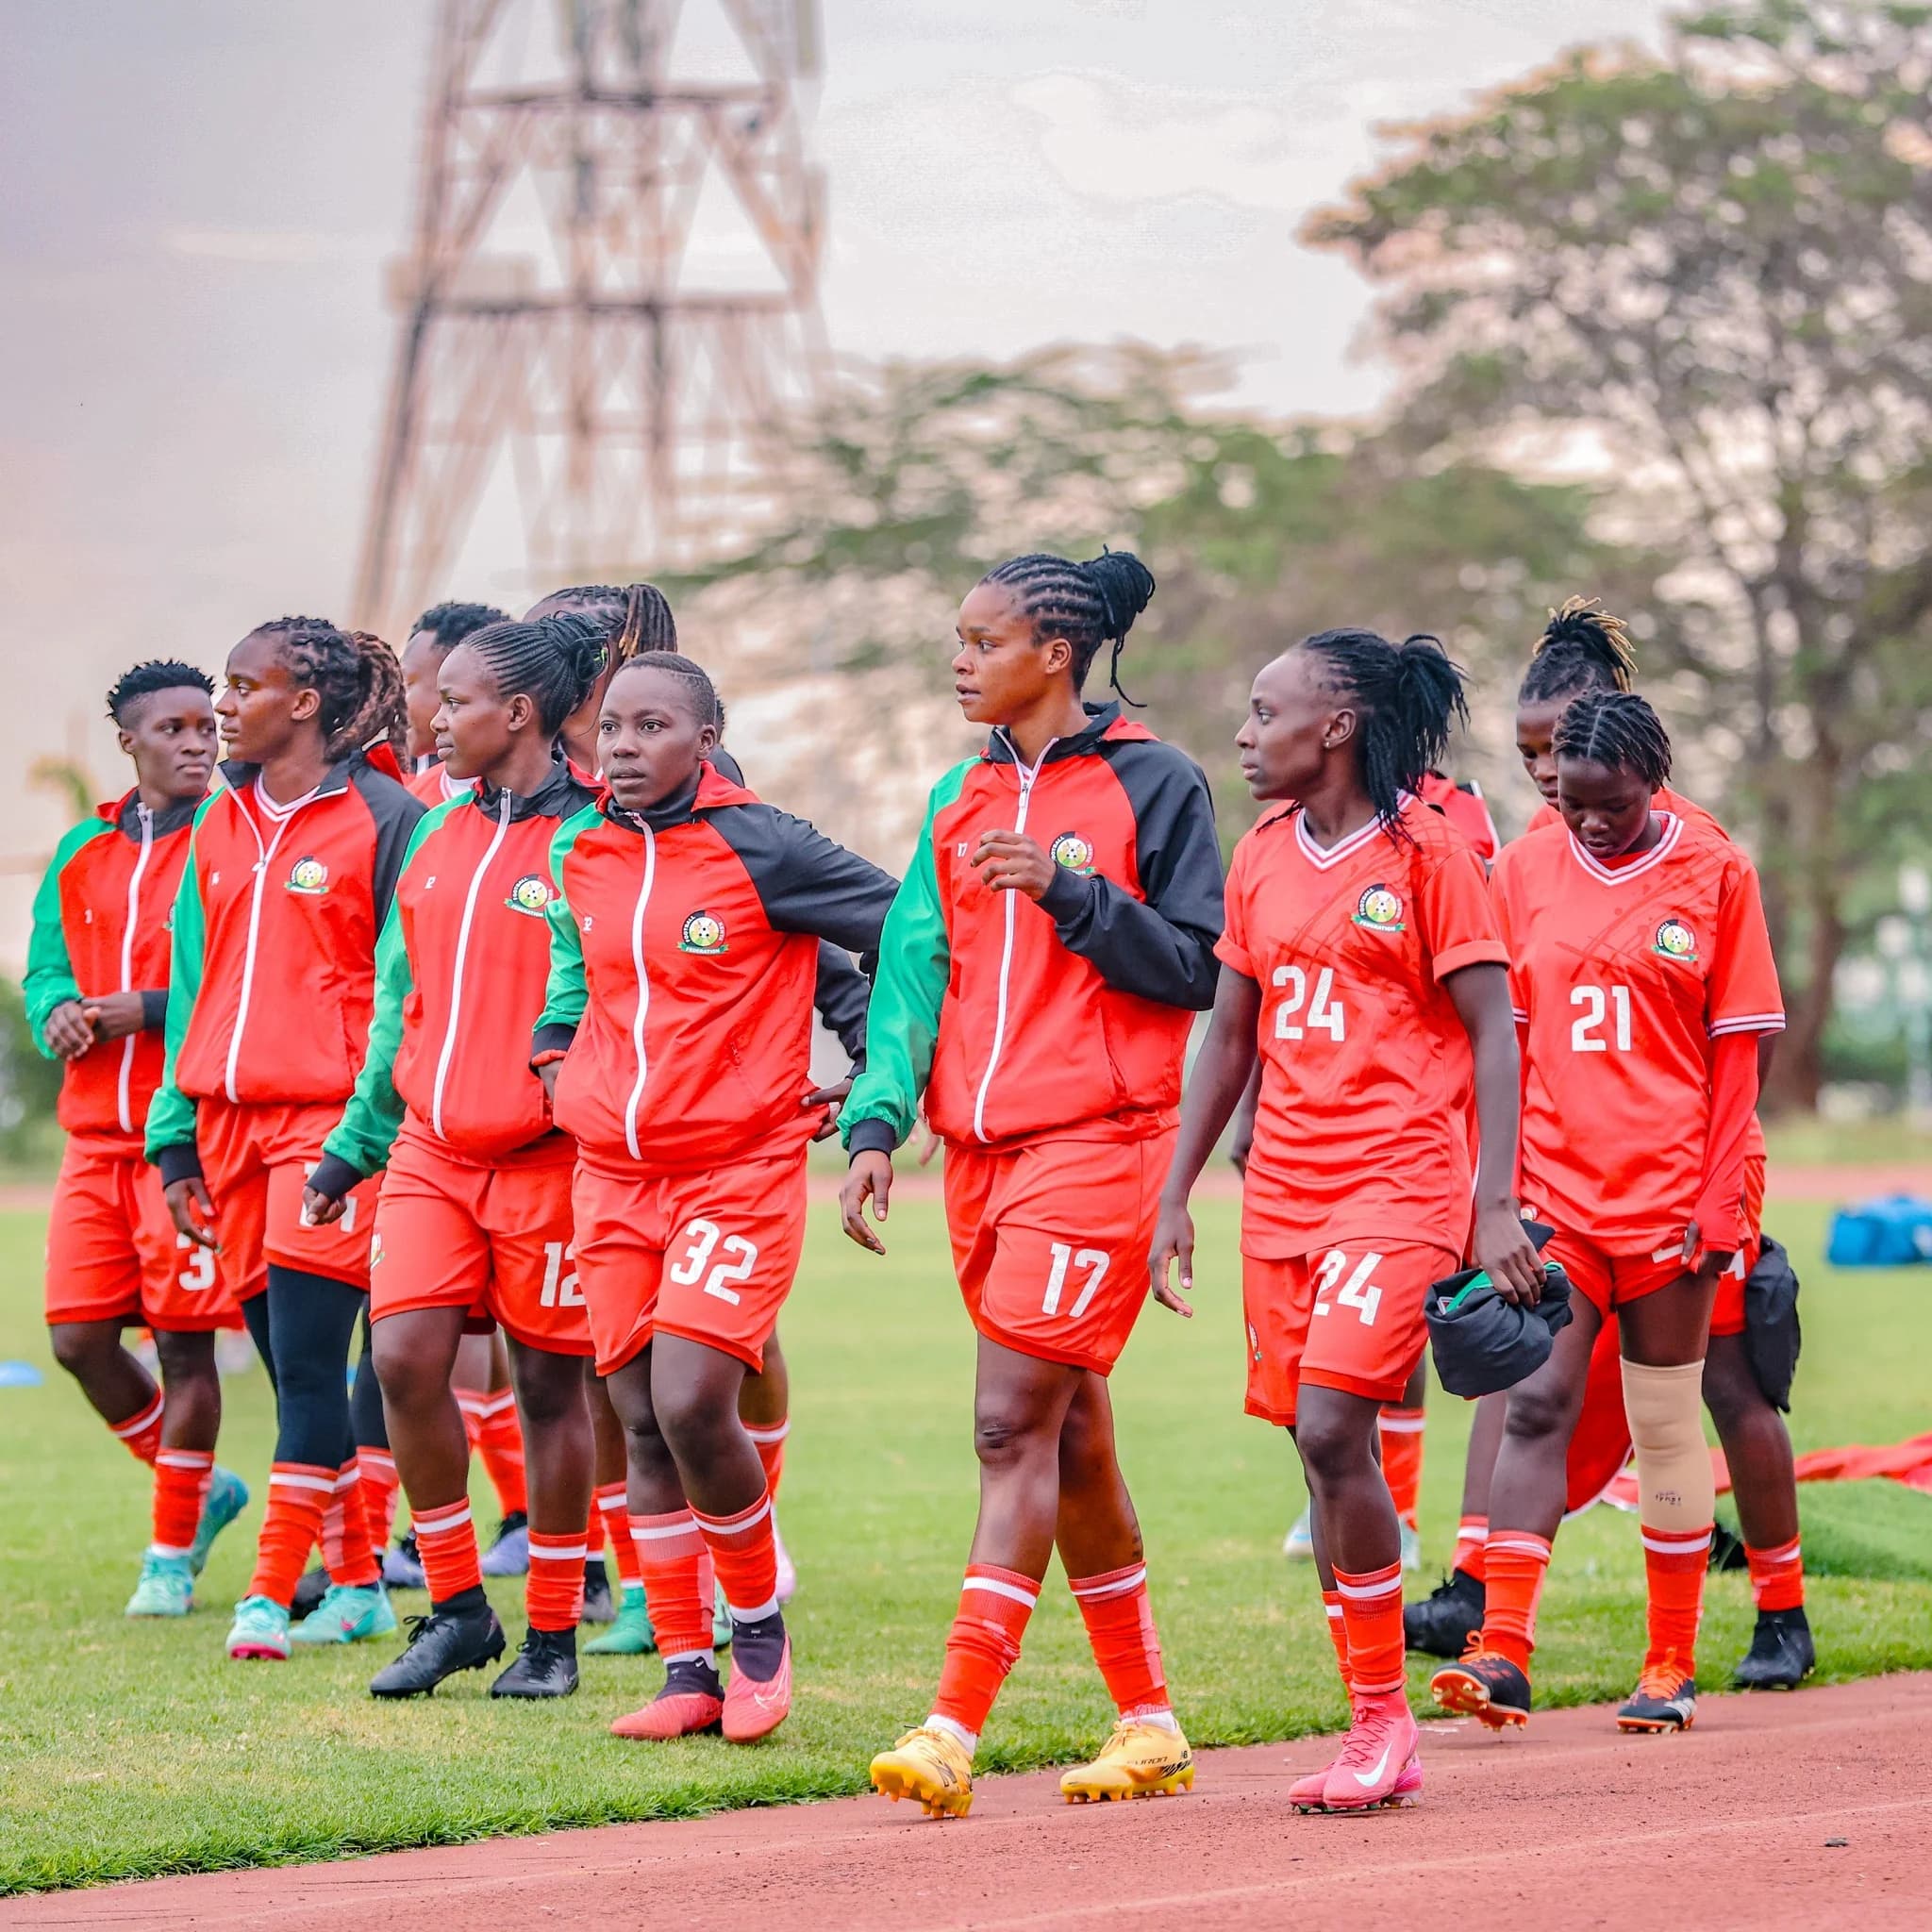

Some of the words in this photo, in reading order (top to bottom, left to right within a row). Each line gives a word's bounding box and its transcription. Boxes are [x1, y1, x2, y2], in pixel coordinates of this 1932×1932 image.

[957, 842, 968, 858] 17
[1050, 835, 1065, 861] OOTBALL
[1358, 887, 1375, 916] FOOTBALL
[683, 915, 696, 943] FOOTBALL
[1358, 920, 1397, 933] FEDERATION
[685, 946, 721, 956] FEDERATION
[1272, 965, 1345, 1042] 24
[1570, 985, 1631, 1052] 21
[670, 1218, 758, 1307] 32
[1041, 1241, 1110, 1318] 17
[1312, 1249, 1384, 1327] 24
